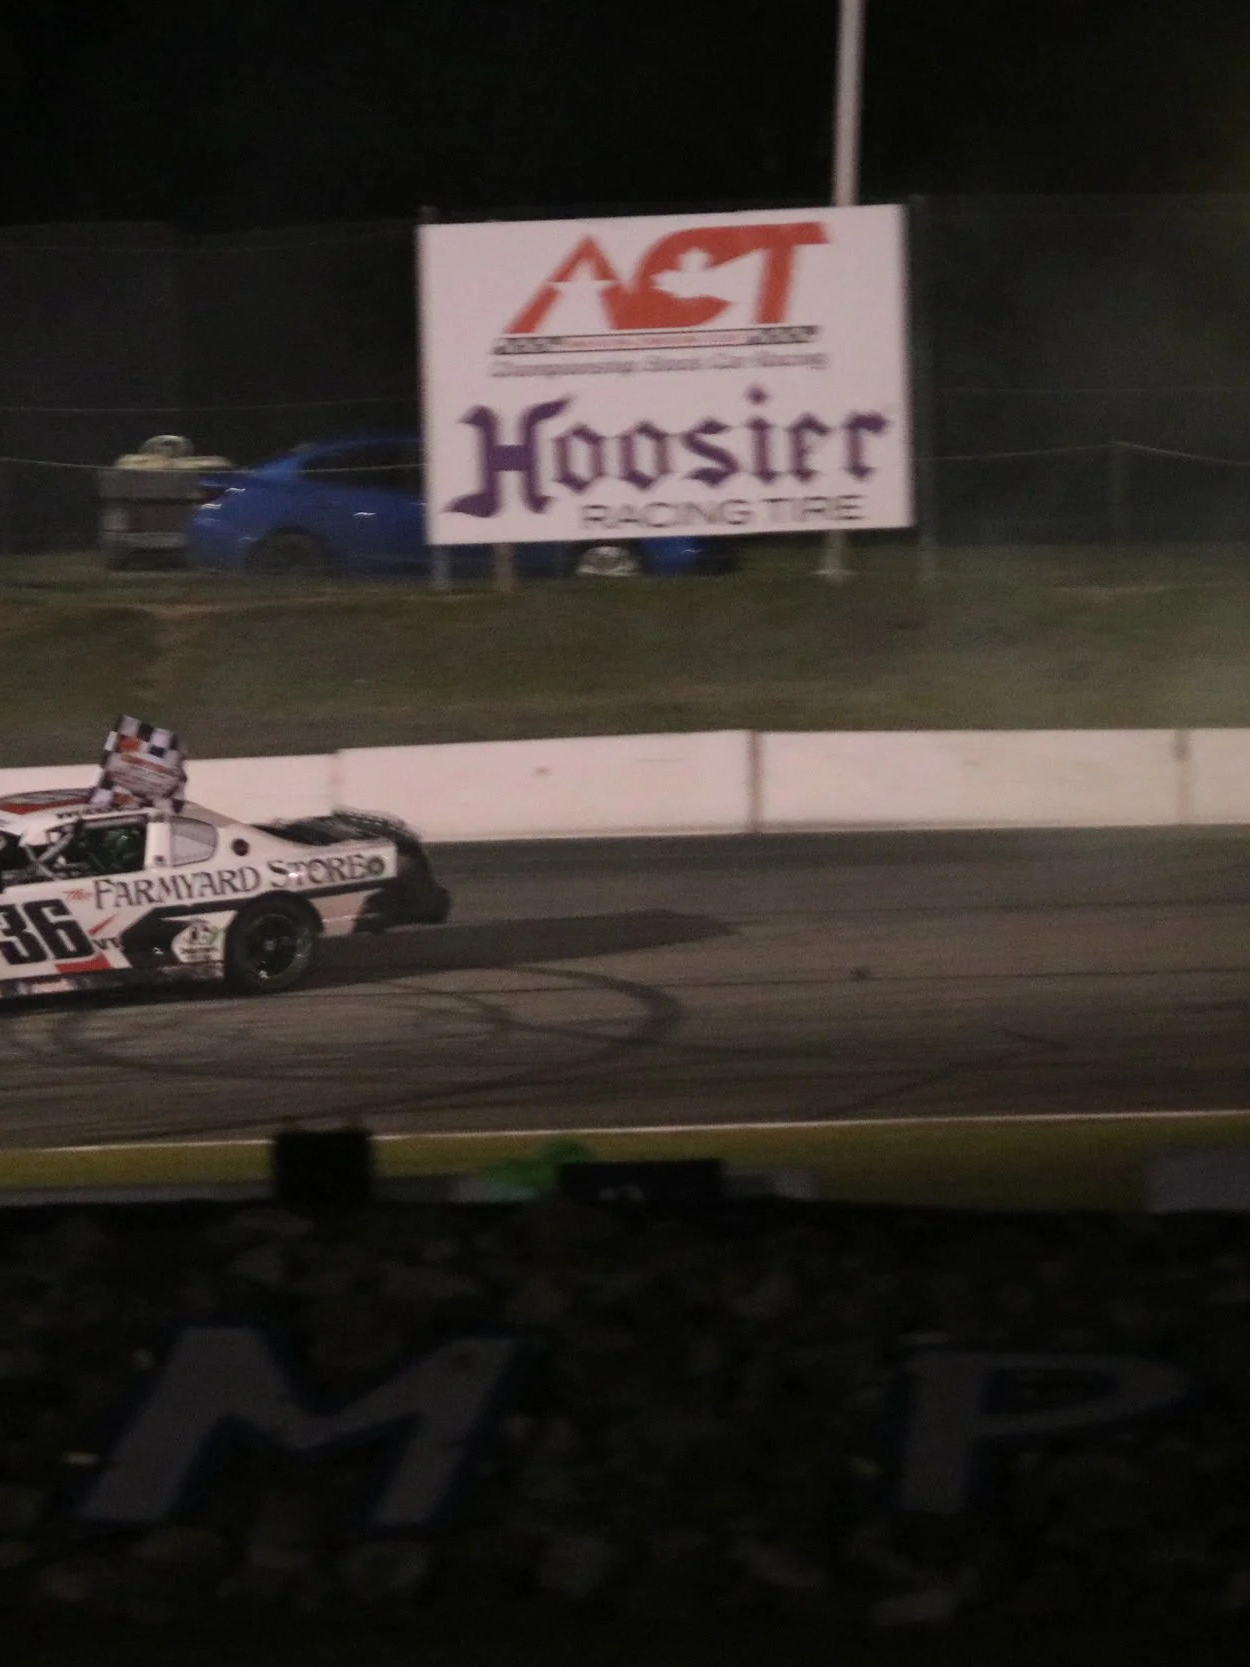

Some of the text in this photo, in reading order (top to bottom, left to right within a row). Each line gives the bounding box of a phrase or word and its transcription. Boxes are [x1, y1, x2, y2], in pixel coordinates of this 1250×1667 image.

[503, 221, 830, 333] ACT
[443, 383, 889, 518] Hoosier
[581, 494, 868, 530] RACING TIRE
[92, 865, 262, 909] FARMYARD
[266, 854, 369, 889] STORE
